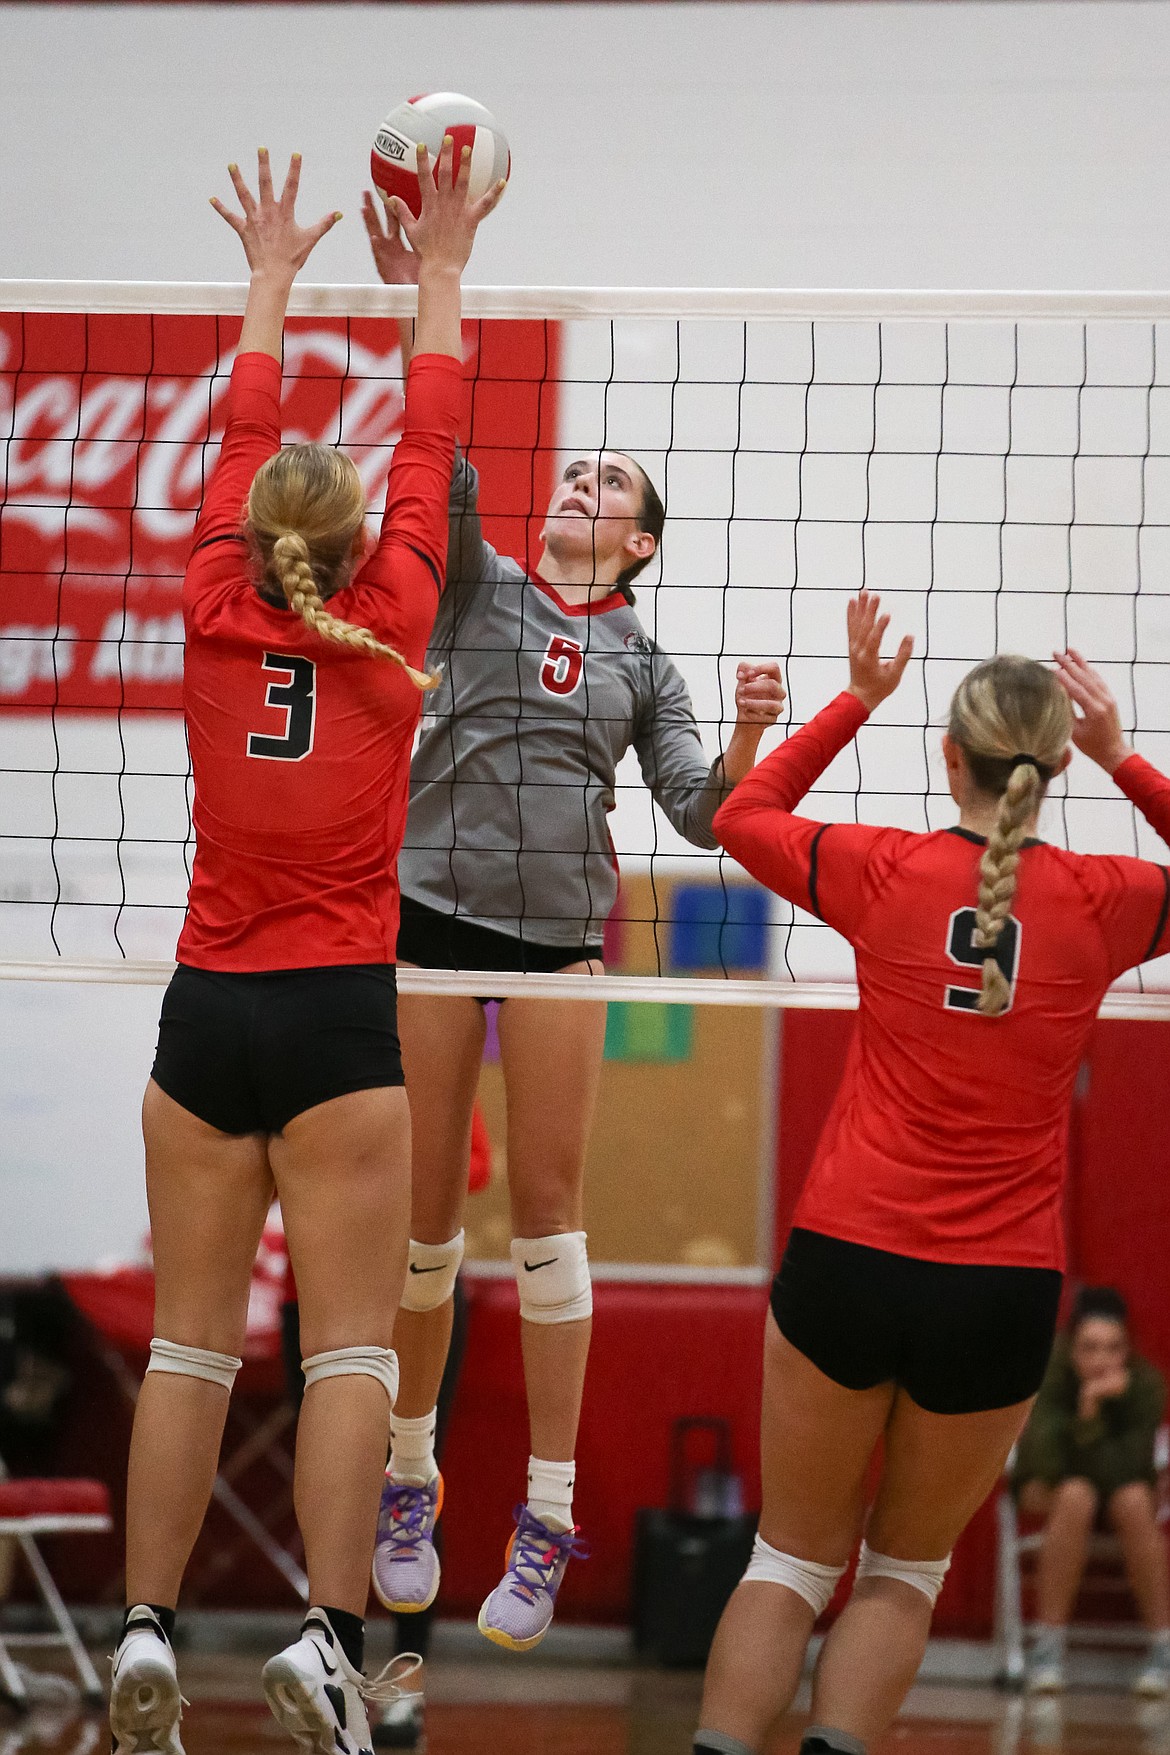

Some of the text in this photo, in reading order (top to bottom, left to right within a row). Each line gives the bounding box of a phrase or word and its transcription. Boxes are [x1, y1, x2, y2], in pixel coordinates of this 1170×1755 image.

[246, 650, 317, 762] 3
[538, 632, 584, 698] 5
[943, 906, 1022, 1018] 9
